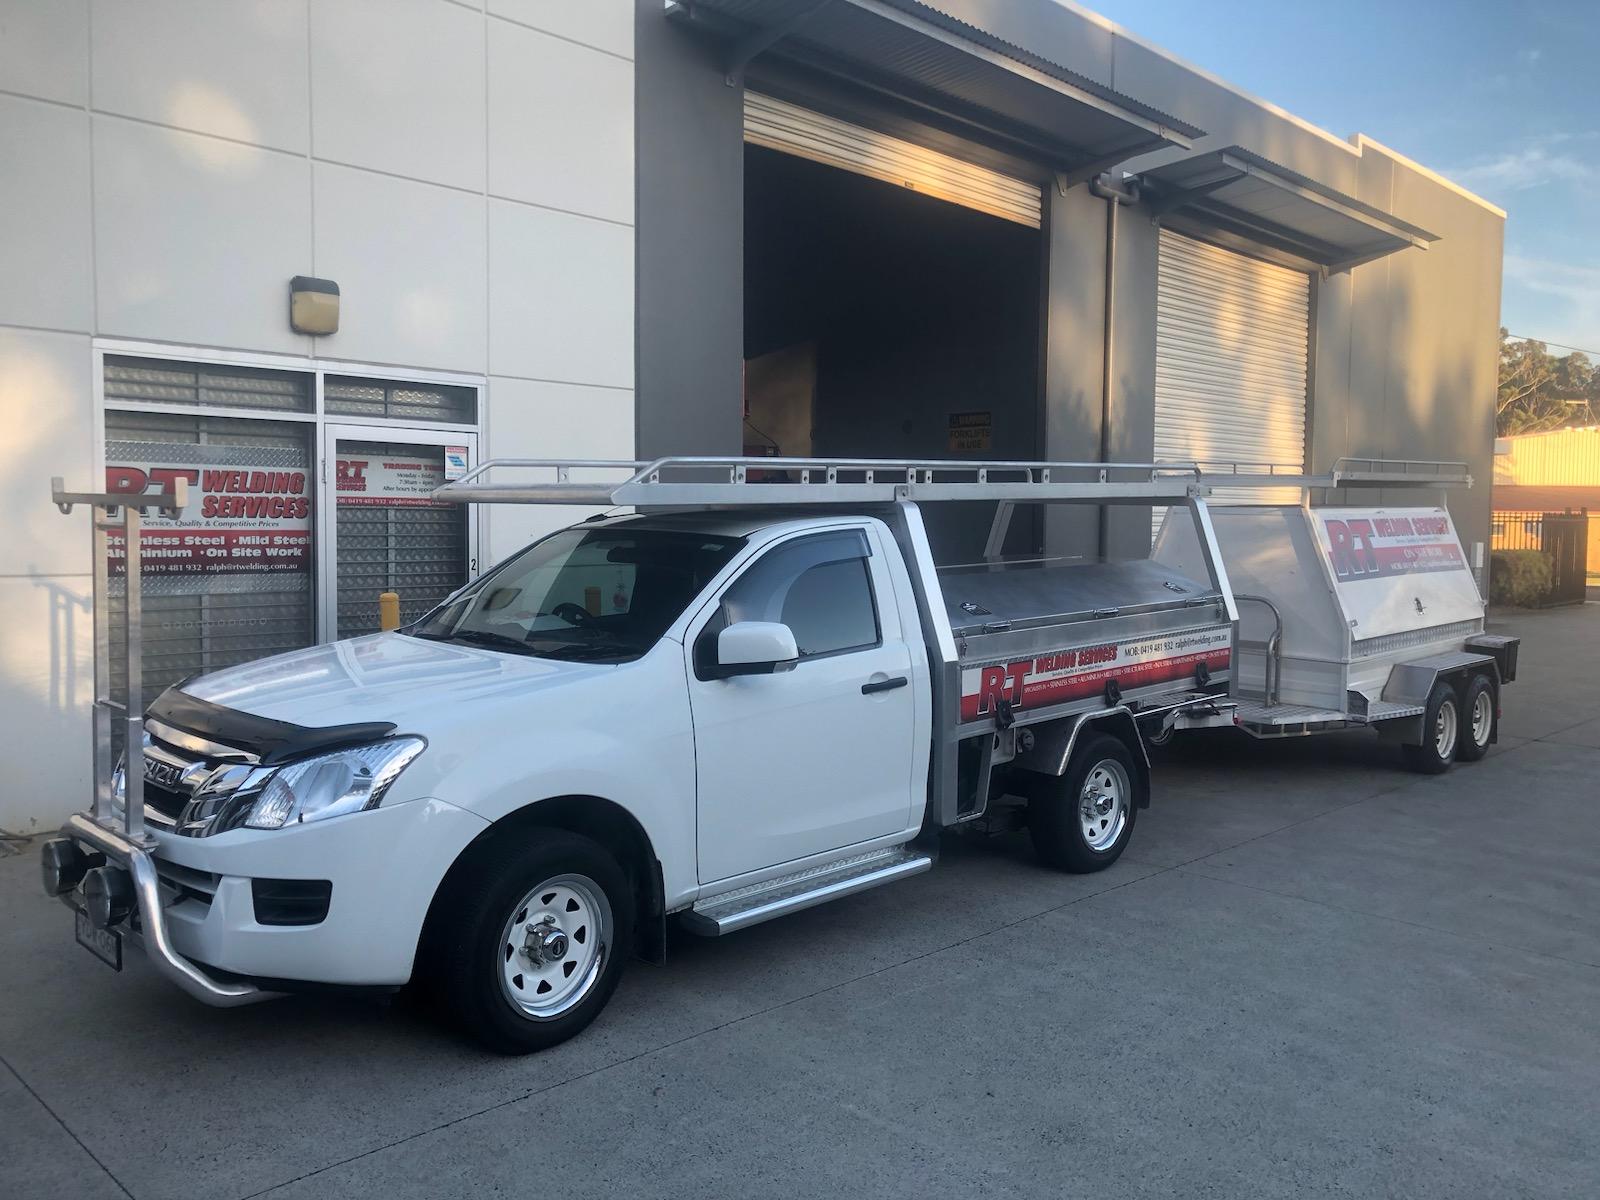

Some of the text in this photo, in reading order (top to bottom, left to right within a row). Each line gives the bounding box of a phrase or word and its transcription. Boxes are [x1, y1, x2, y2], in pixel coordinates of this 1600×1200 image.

[202, 469, 305, 494] WELDING
[201, 494, 310, 519] SERVICES
[175, 520, 202, 528] Quality
[213, 520, 256, 528] Competitive
[1372, 517, 1414, 537] WELDING
[184, 536, 225, 545] Steel
[238, 536, 269, 545] Mild
[1325, 519, 1380, 577] RT
[206, 548, 227, 557] On
[232, 547, 261, 557] Site
[266, 547, 303, 557] Work
[144, 564, 166, 572] 0419
[168, 564, 184, 572] 481
[186, 564, 202, 572] 932
[206, 563, 298, 573] ralph@rtwelding.com.au
[471, 558, 477, 571] 2
[1124, 647, 1140, 656] MOB:
[1141, 645, 1153, 654] 0419
[1154, 643, 1163, 652] 481
[1164, 641, 1173, 650] 932
[1036, 644, 1118, 674] WELDING SERVICES
[977, 661, 1032, 714] RT
